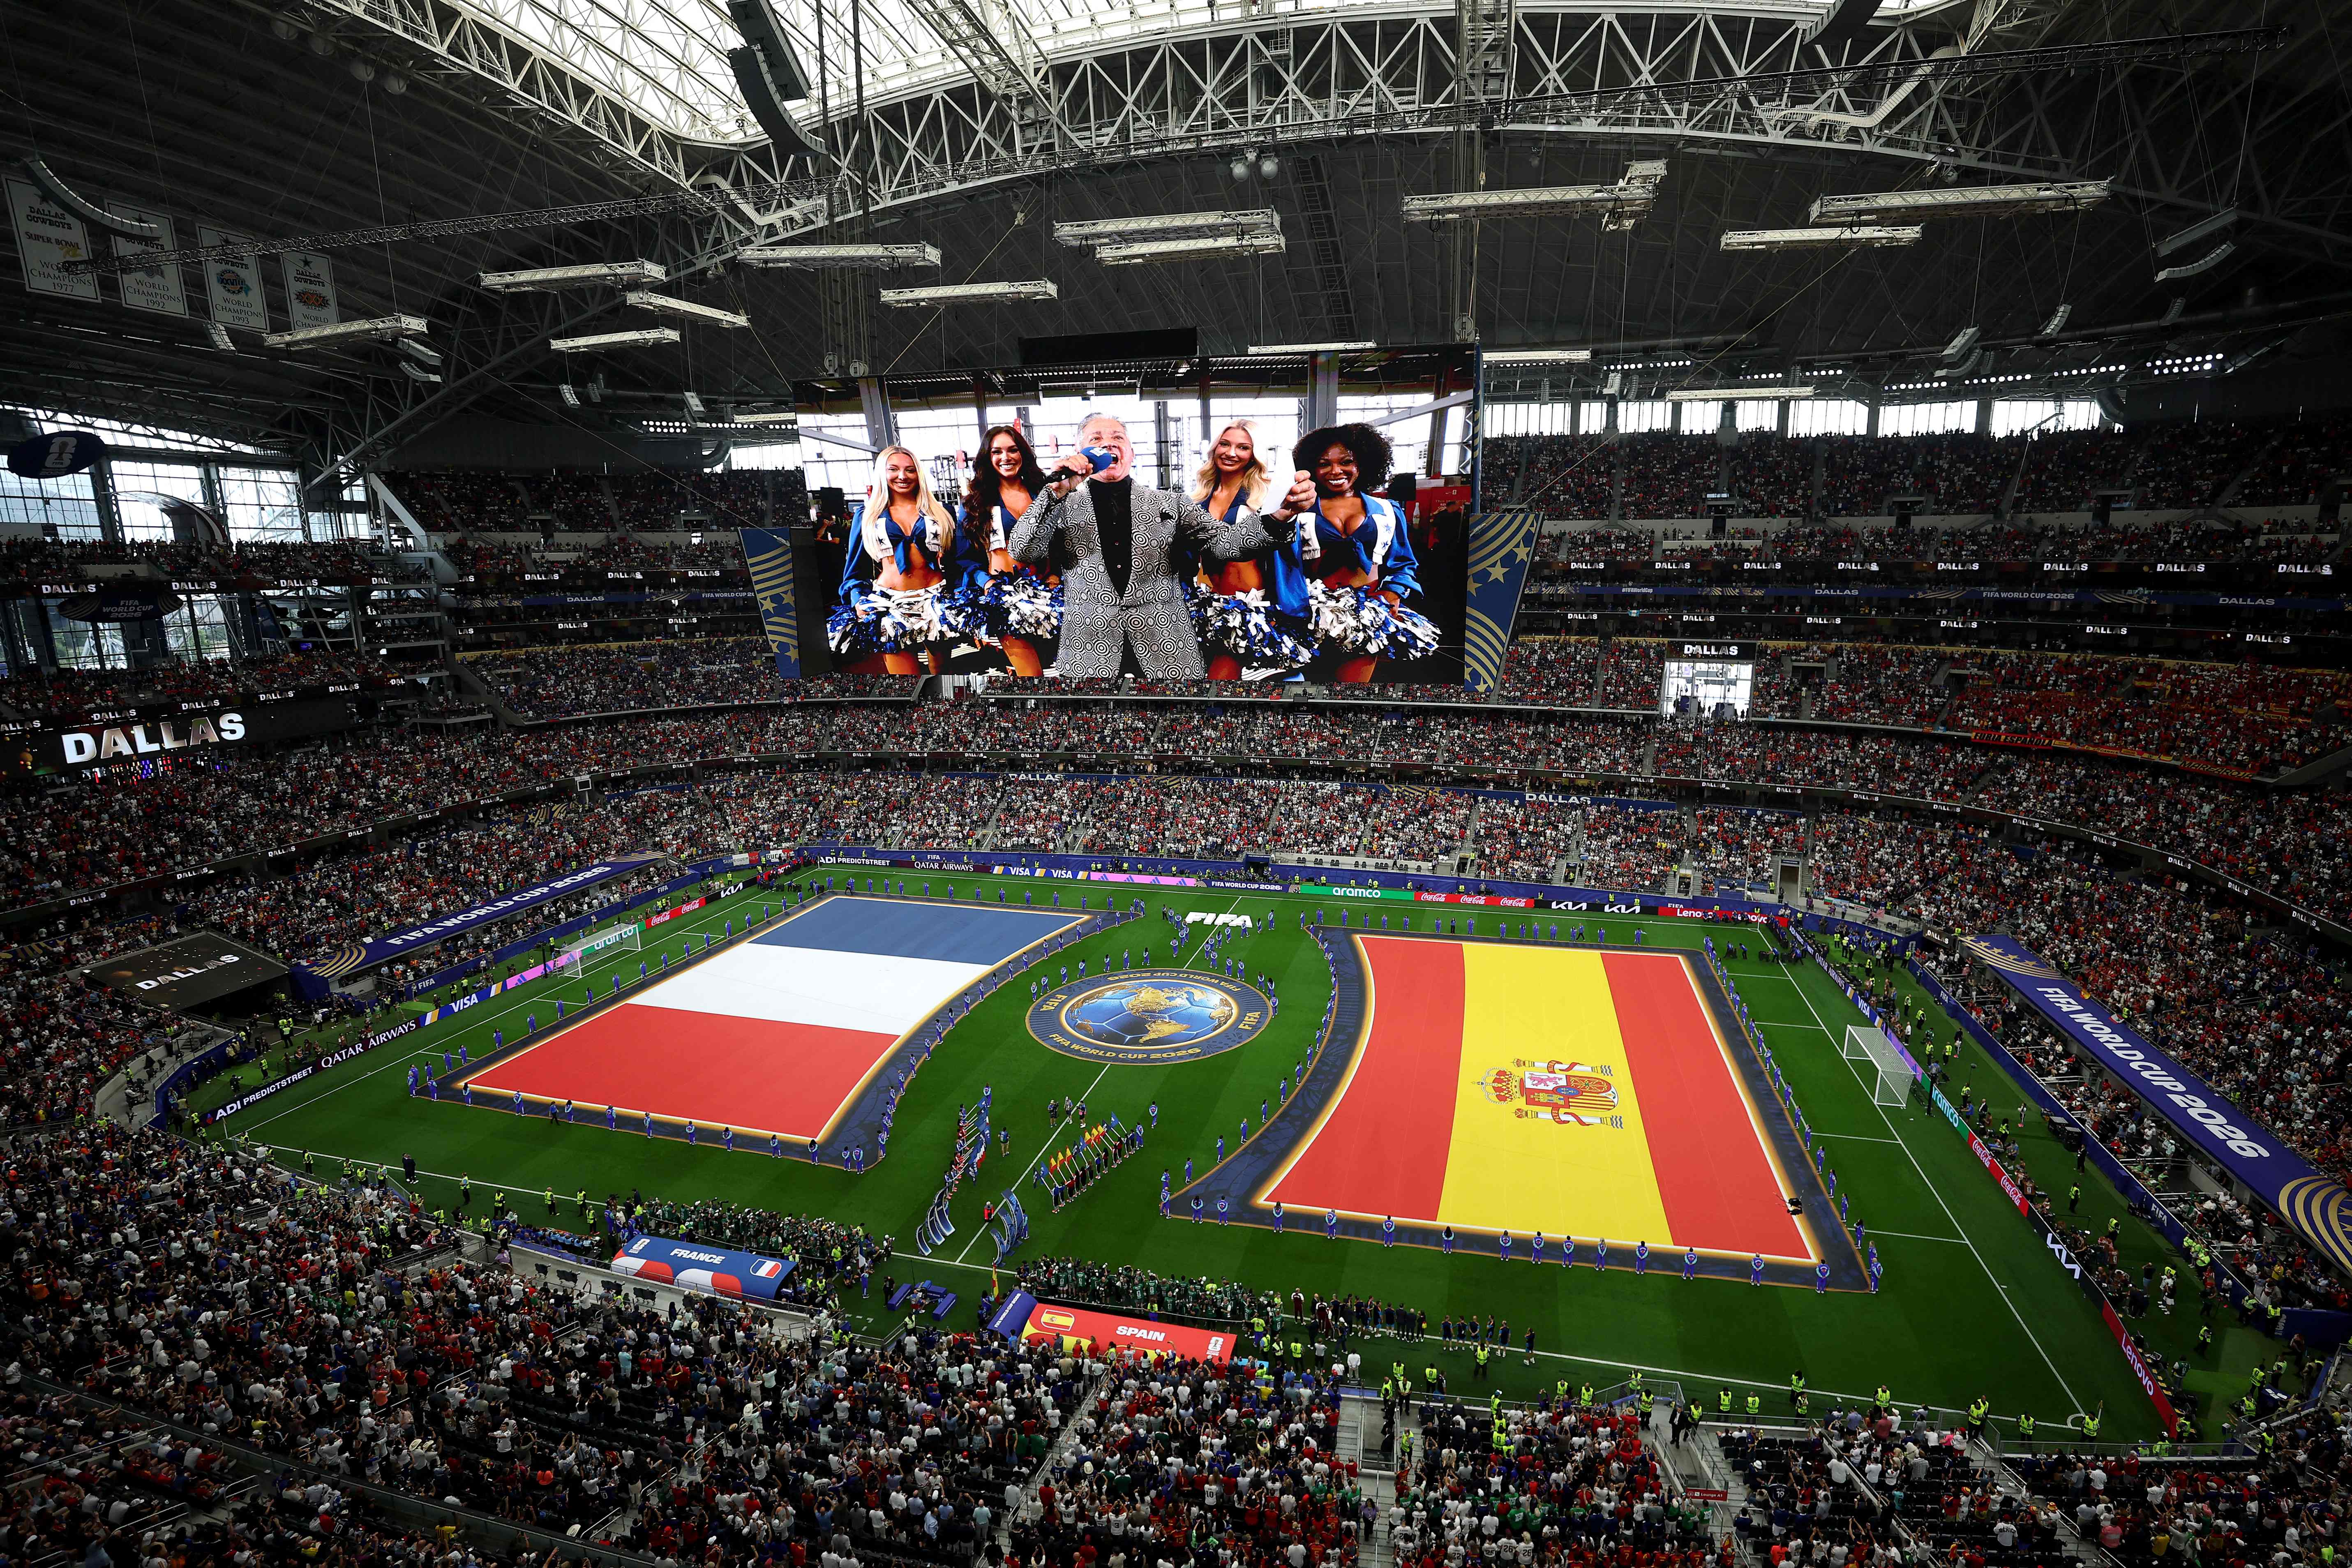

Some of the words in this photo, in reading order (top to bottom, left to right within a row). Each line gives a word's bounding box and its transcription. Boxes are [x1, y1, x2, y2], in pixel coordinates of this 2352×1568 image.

[29, 206, 66, 220] DALLAS
[27, 215, 72, 230] COWBOYS
[25, 231, 52, 244] SUPER
[55, 239, 81, 249] BOWL
[30, 268, 92, 286] CHAMPIONS
[296, 269, 321, 279] DALLAS
[53, 282, 74, 293] 1977
[135, 278, 168, 291] WORLD
[294, 276, 325, 287] COWBOYS
[127, 286, 181, 303] CHAMPIONS
[146, 299, 166, 309] 1992
[222, 296, 252, 308] WORLD
[215, 304, 263, 318] CHAMPIONS
[232, 315, 249, 325] 1993
[302, 312, 328, 324] WORLD
[2278, 565, 2330, 573] DALLAS
[42, 584, 96, 593] DALLAS
[2246, 634, 2290, 643] DALLAS
[1684, 645, 1738, 655] DALLAS
[329, 684, 359, 692] DALLAS
[260, 691, 293, 700] DALLAS
[182, 700, 219, 709] DALLAS
[93, 709, 136, 720] DALLAS
[62, 713, 245, 763] DALLAS
[1975, 733, 2001, 741] FURIA
[819, 856, 836, 864] ADI
[838, 858, 890, 866] PREDICTSTREET
[914, 861, 939, 870] QATAR
[942, 863, 974, 872] AIRWAYS
[1009, 867, 1031, 876] VISA
[1050, 869, 1073, 879] VISA
[658, 885, 669, 894] FIFA
[1332, 887, 1381, 898] aramco
[1421, 893, 1447, 902] Coca-Cola
[1460, 895, 1486, 905] Coca-Cola
[1500, 898, 1527, 908] Coca-Cola
[386, 927, 437, 945] FIFA
[435, 900, 516, 930] WORLD
[512, 887, 551, 902] CUP
[549, 866, 613, 888] 2026
[681, 899, 700, 914] Coca-Cola
[651, 910, 671, 926] Coca-Cola
[1185, 912, 1253, 928] FIFA
[1927, 930, 1948, 944] DALLAS
[1107, 972, 1152, 981] 2026
[1815, 952, 1828, 972] QATAR
[1828, 964, 1846, 991] AIRWAYS
[418, 978, 436, 989] FIFA
[1179, 973, 1219, 984] WORLD
[1221, 981, 1242, 992] FIFA
[1040, 994, 1067, 1012] FIFA
[1940, 990, 1949, 1004] FIFA
[449, 996, 478, 1012] VISA
[1857, 997, 1870, 1018] VISA
[1239, 1011, 1261, 1030] FIFA
[321, 1043, 364, 1068] QATAR
[368, 1020, 416, 1049] AIRWAYS
[1048, 1033, 1072, 1049] FIFA
[1069, 1043, 1117, 1058] WORLD
[1149, 1046, 1203, 1059] 2026
[2036, 987, 2083, 1013] FIFA
[2069, 1013, 2145, 1060] WORLD
[2129, 1061, 2187, 1092] CUP
[2166, 1094, 2270, 1158] 2026
[215, 1101, 242, 1120] ADI
[243, 1067, 313, 1103] PREDICTSTREET
[1972, 1139, 1991, 1168] Coca-Cola
[2001, 1175, 2022, 1207] Coca-Cola
[2151, 1202, 2167, 1227] FIFA
[670, 1248, 725, 1264] FRANCE
[999, 1309, 1009, 1322] WORLD
[1011, 1293, 1022, 1305] 2026
[1116, 1325, 1166, 1342] SPAIN
[2121, 1333, 2155, 1397] Lenovo
